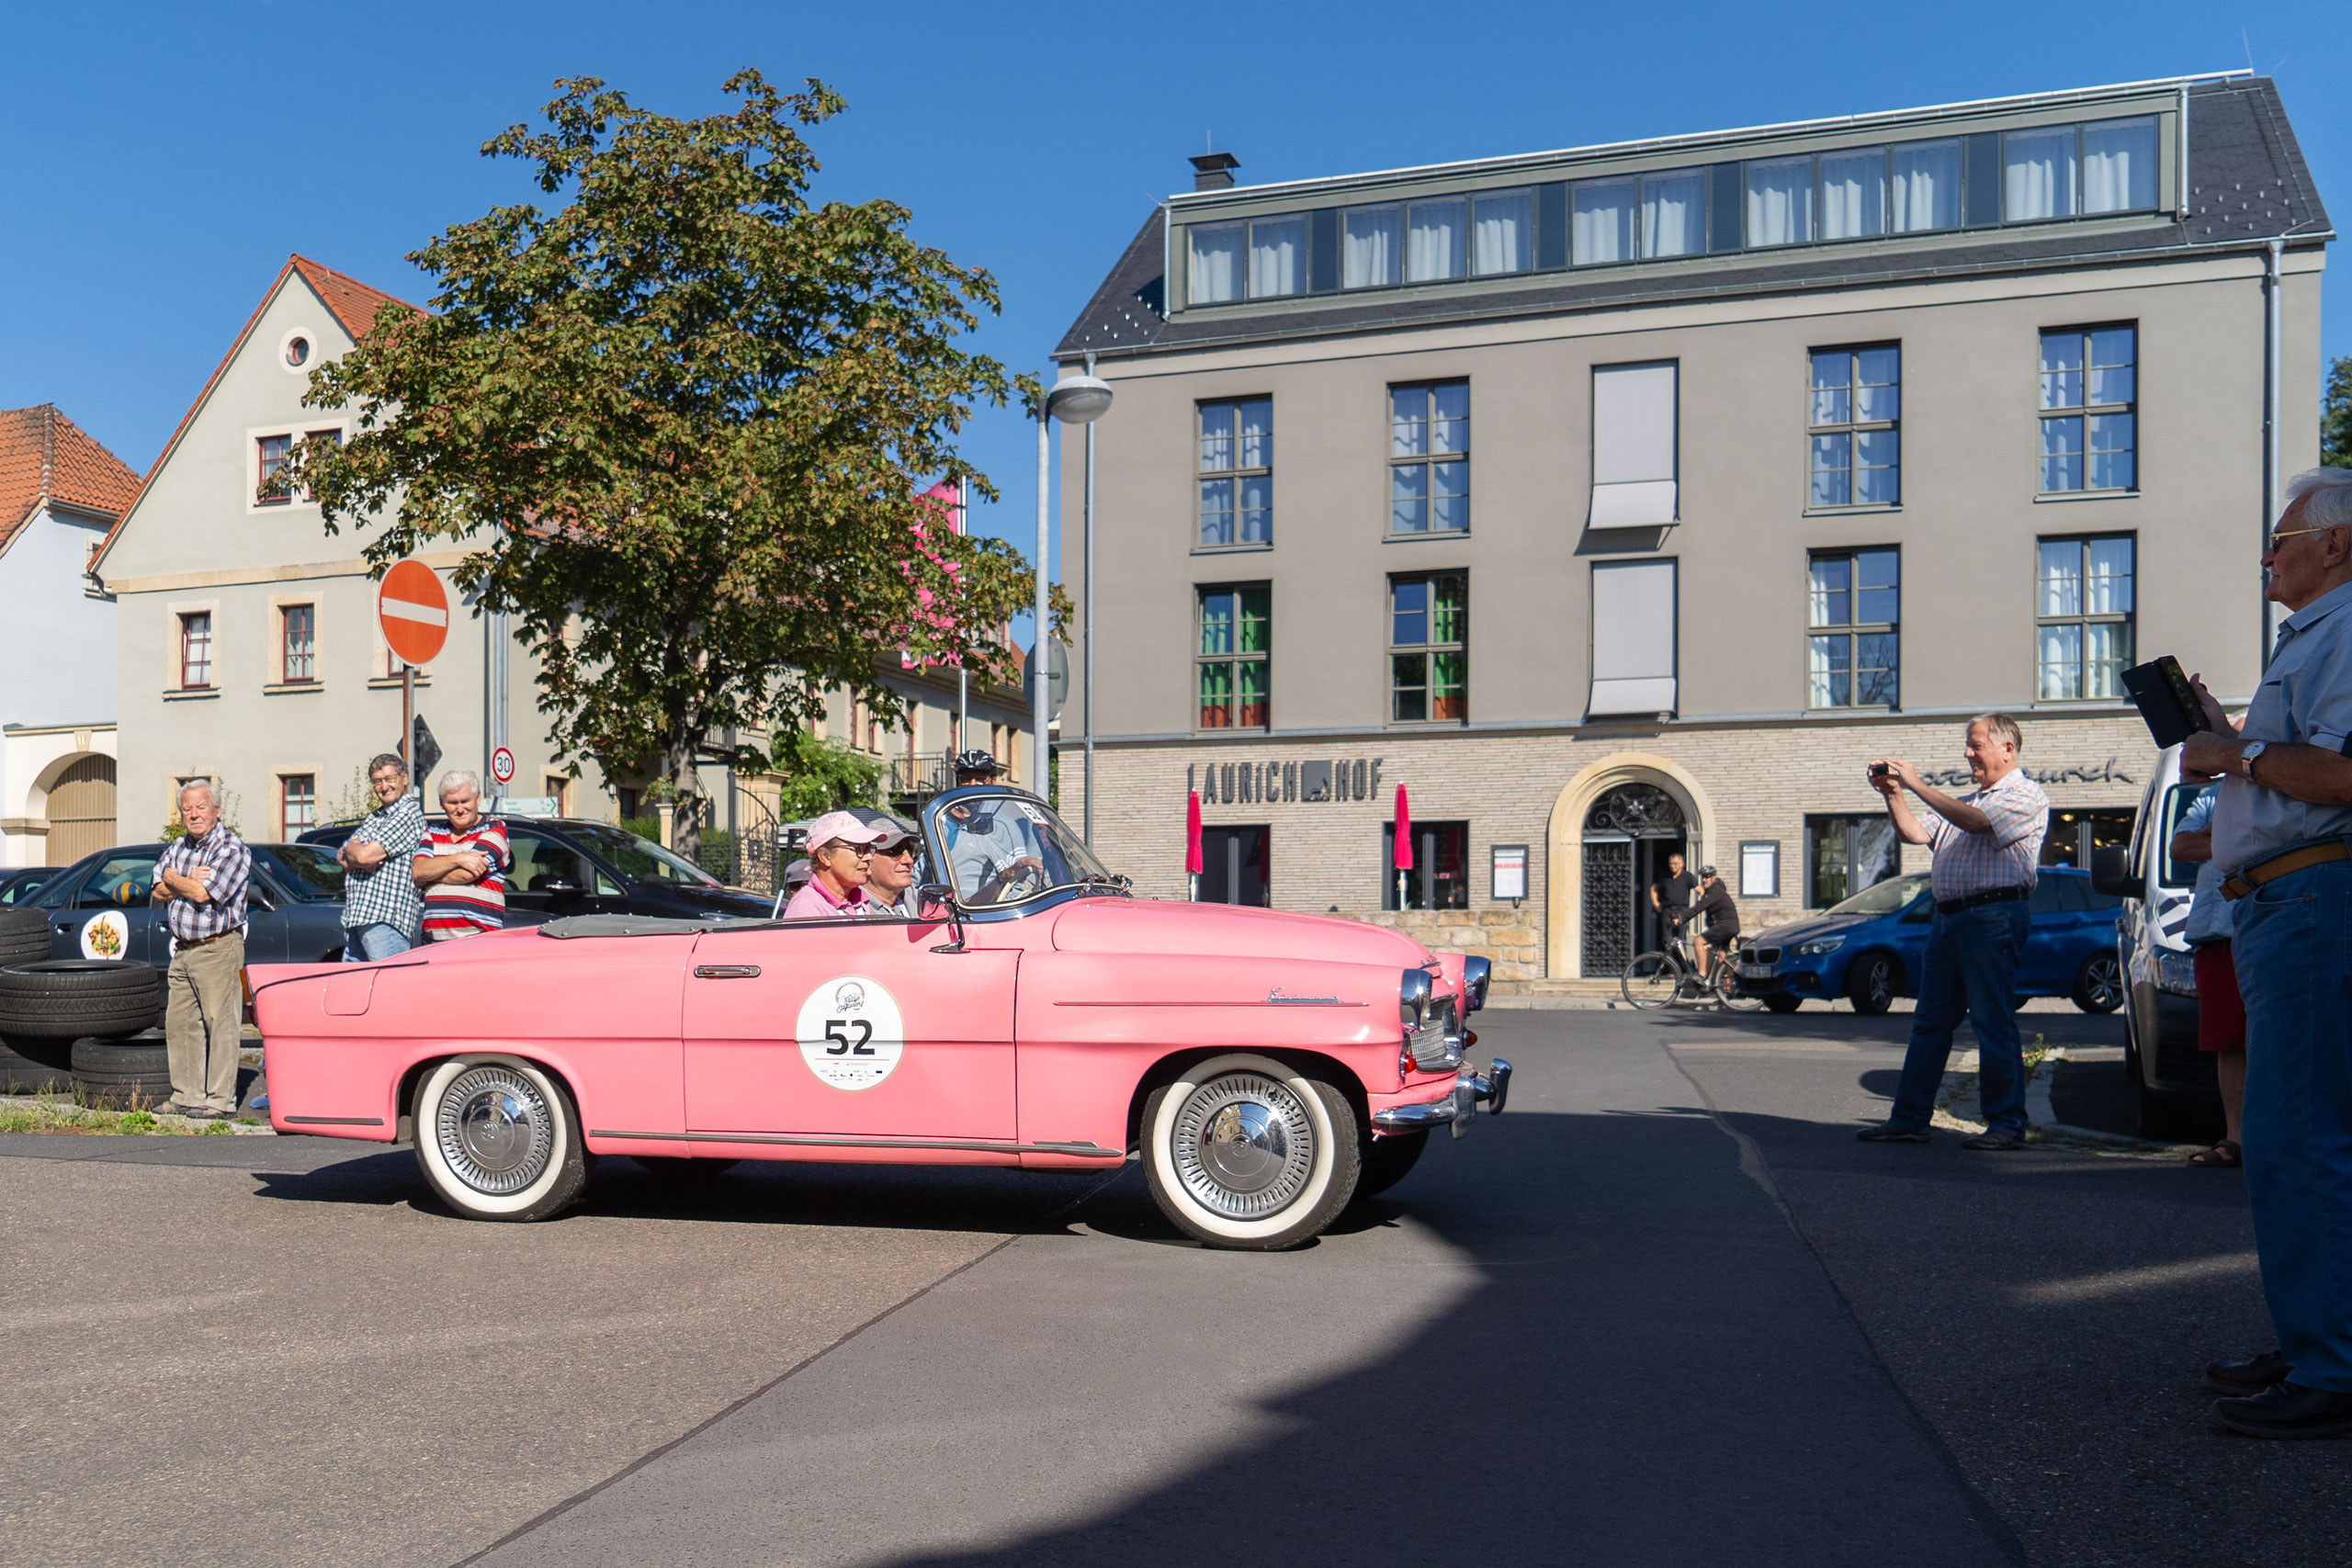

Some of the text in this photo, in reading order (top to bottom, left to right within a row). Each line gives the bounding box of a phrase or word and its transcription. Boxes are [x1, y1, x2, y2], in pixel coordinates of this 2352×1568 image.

[497, 756, 511, 773] 30
[1336, 758, 1384, 802] HOF
[825, 1020, 875, 1055] 52
